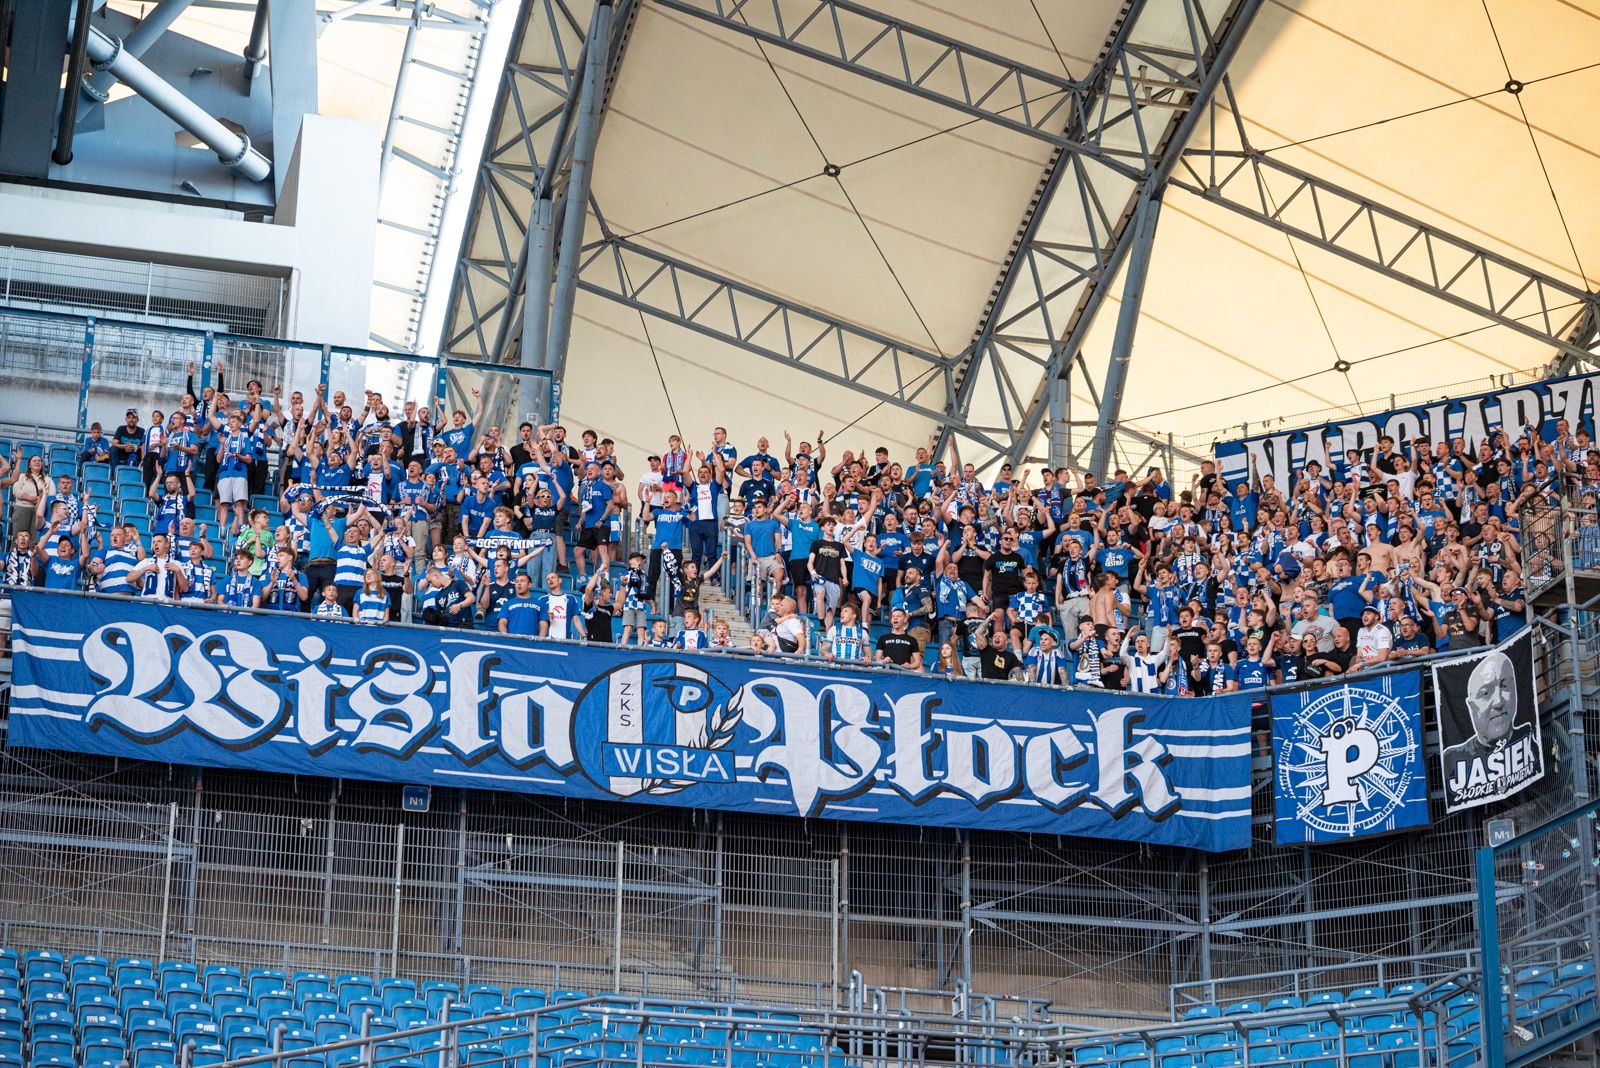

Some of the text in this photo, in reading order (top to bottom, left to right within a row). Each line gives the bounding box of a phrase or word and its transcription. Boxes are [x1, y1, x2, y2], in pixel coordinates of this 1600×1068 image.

[476, 538, 535, 549] GOSTYNIN
[679, 685, 702, 706] P
[83, 622, 577, 768] Wisła
[740, 676, 1180, 818] Płock
[614, 748, 729, 780] WISŁA
[1450, 734, 1535, 792] JASIEK
[409, 796, 424, 806] N1
[1494, 830, 1510, 840] M1
